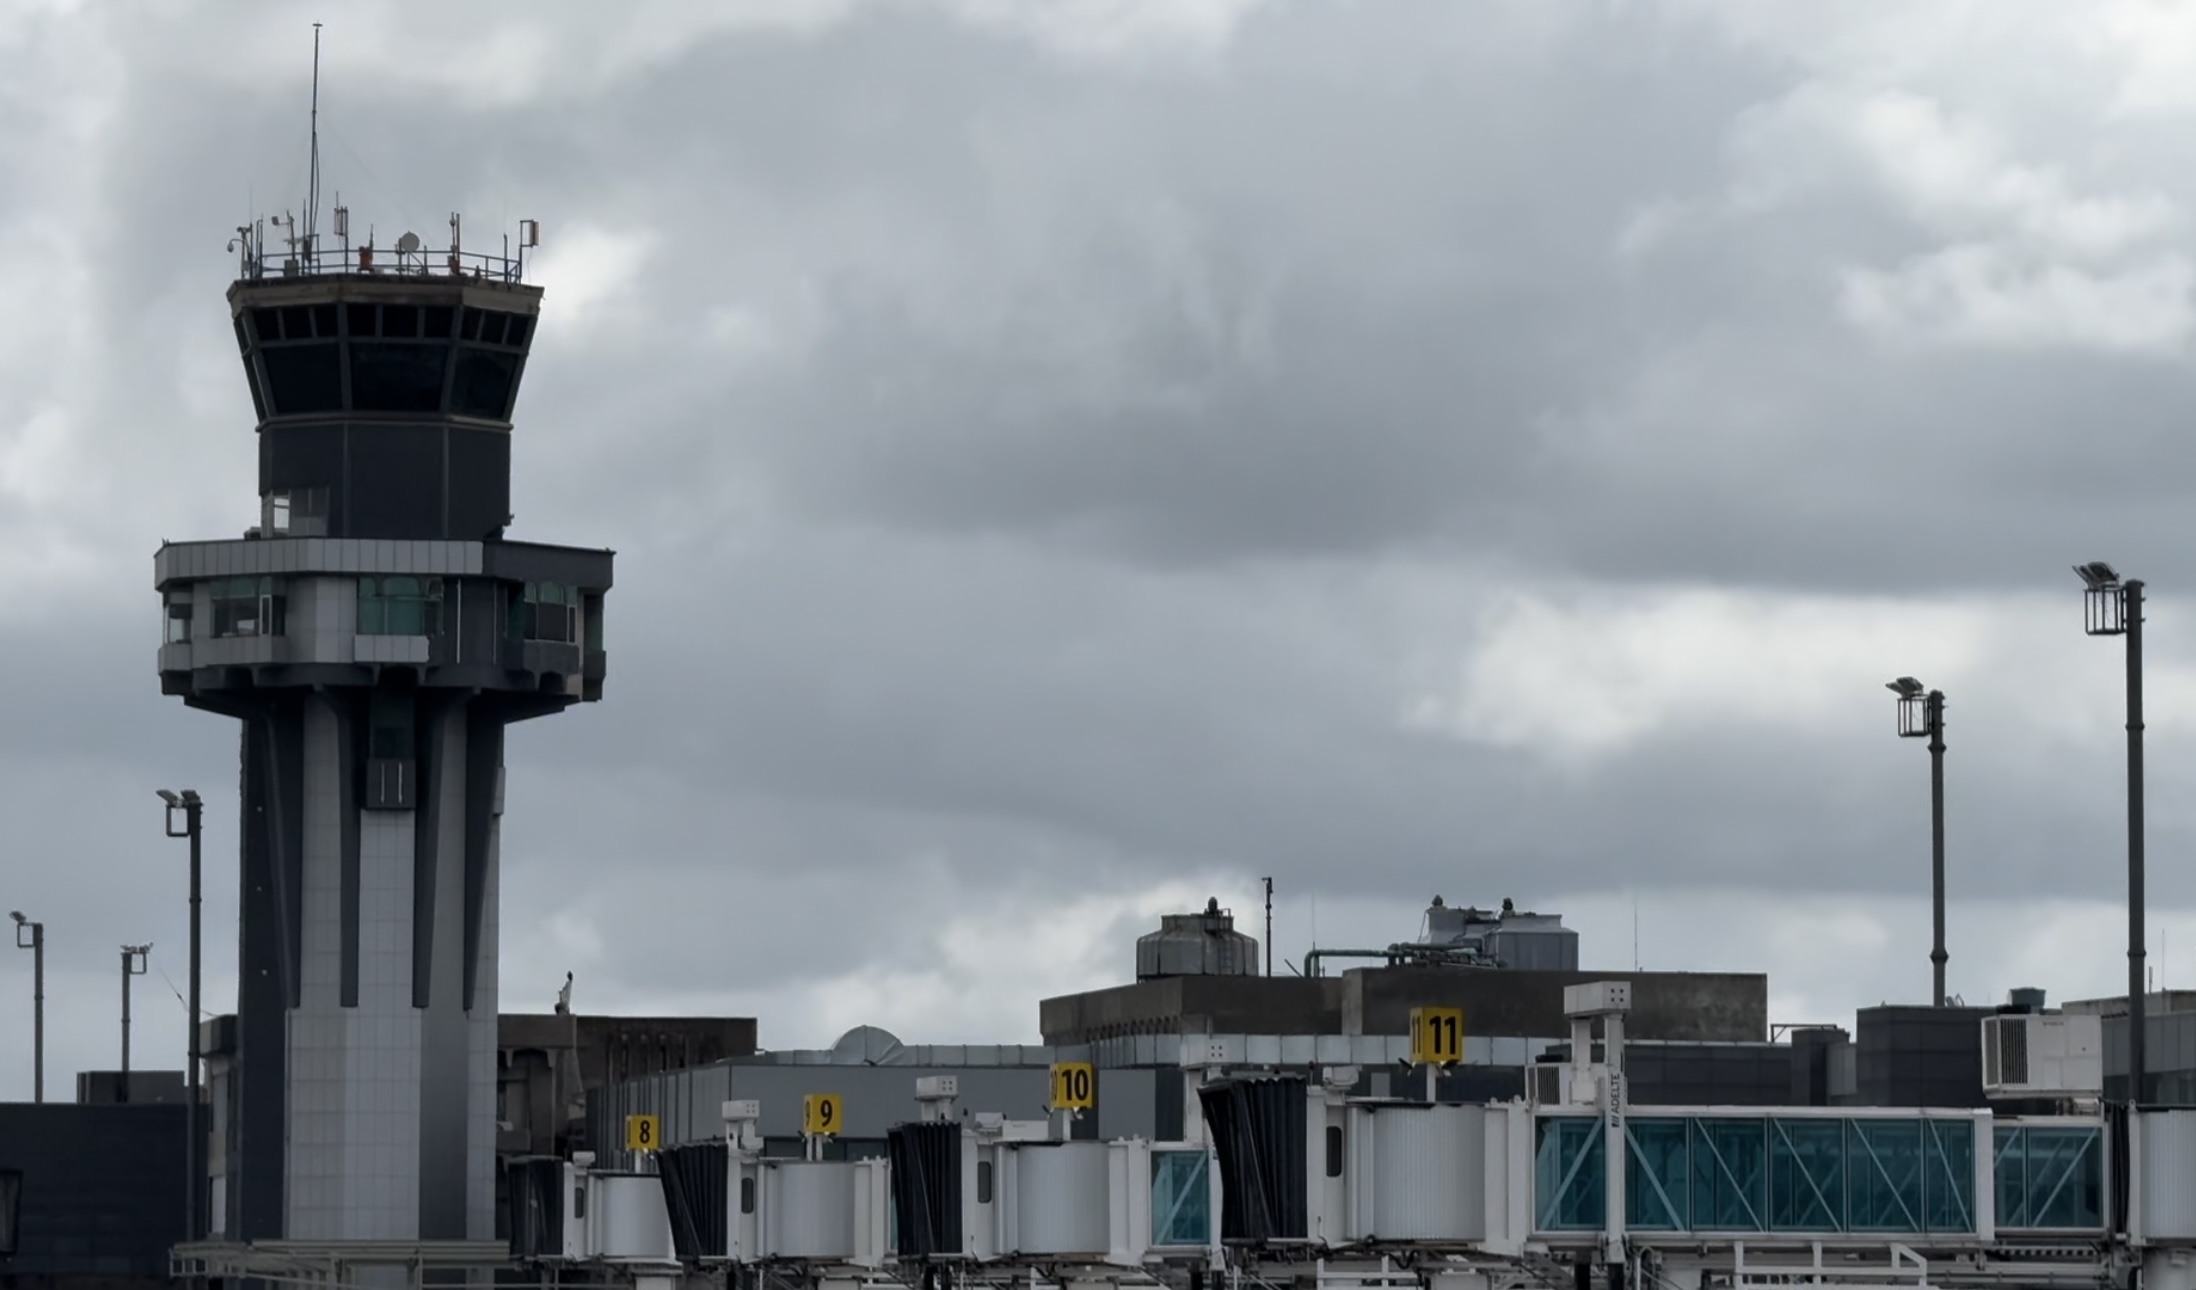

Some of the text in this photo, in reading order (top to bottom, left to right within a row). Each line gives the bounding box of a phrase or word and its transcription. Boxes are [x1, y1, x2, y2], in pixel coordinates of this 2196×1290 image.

[1429, 1015, 1456, 1055] 11
[1061, 1068, 1089, 1101] 10
[1610, 1073, 1620, 1114] ADELTE
[820, 1099, 833, 1127] 9
[639, 1119, 651, 1144] 8
